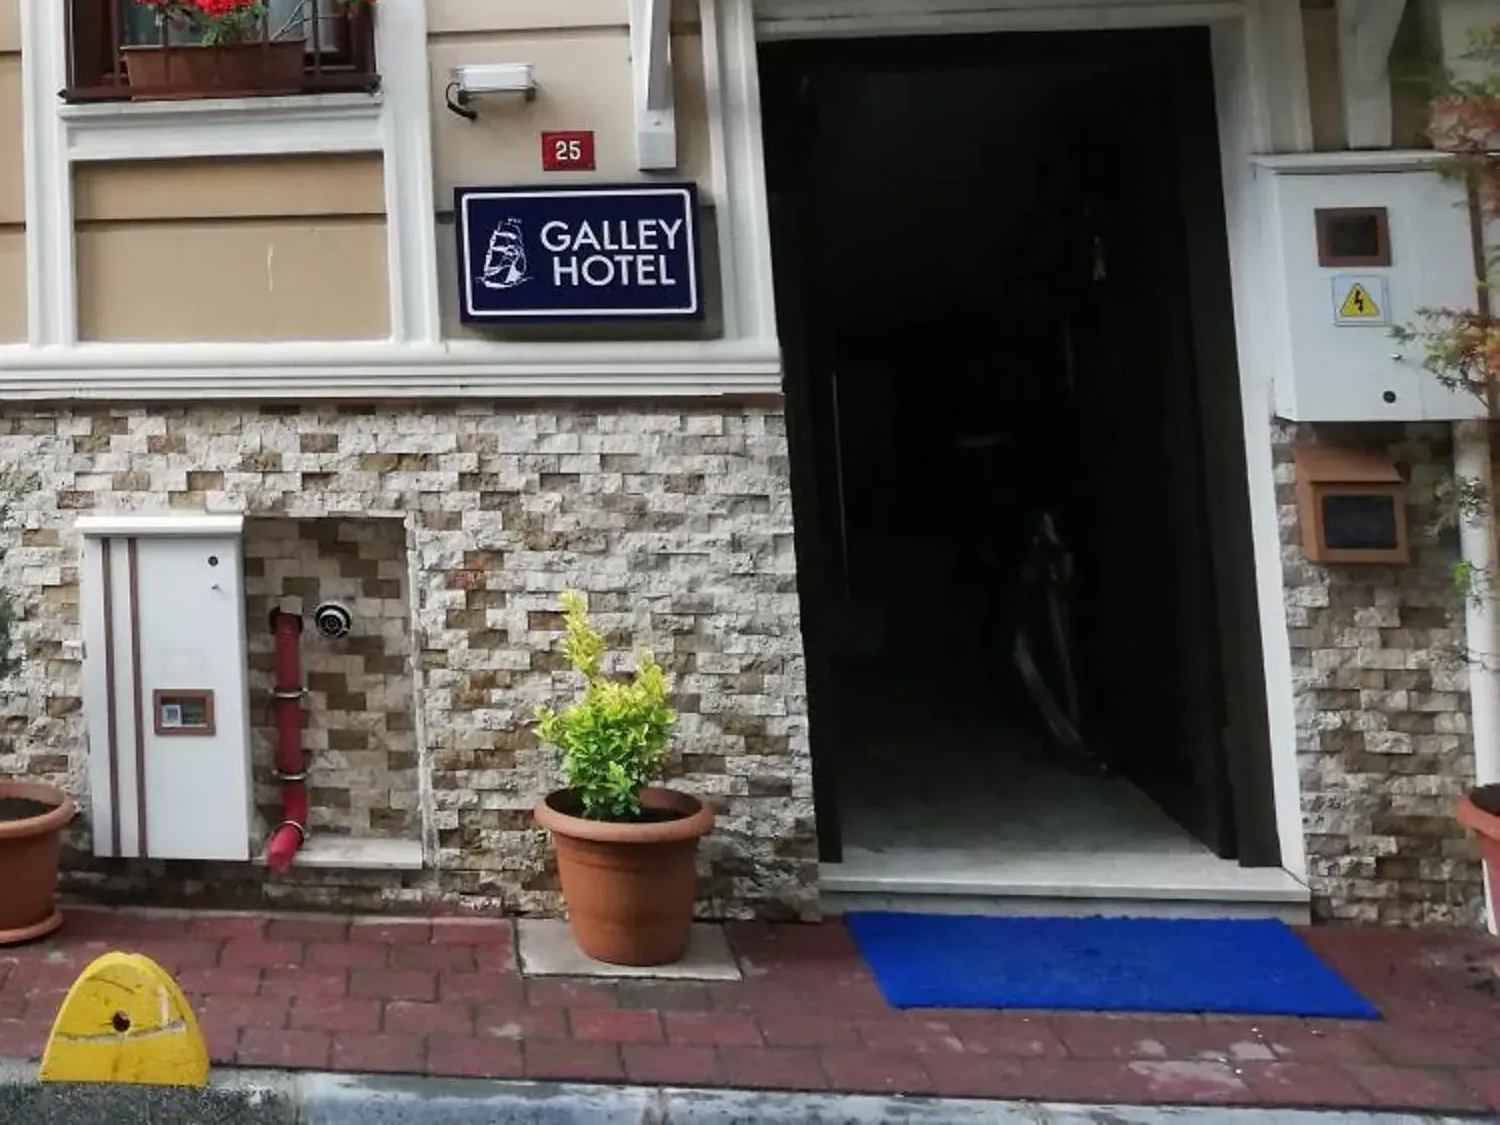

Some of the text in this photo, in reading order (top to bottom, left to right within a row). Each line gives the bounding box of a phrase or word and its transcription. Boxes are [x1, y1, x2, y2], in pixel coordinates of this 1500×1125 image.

[555, 140, 581, 160] 25
[540, 219, 682, 251] GALLEY
[553, 254, 676, 286] HOTEL
